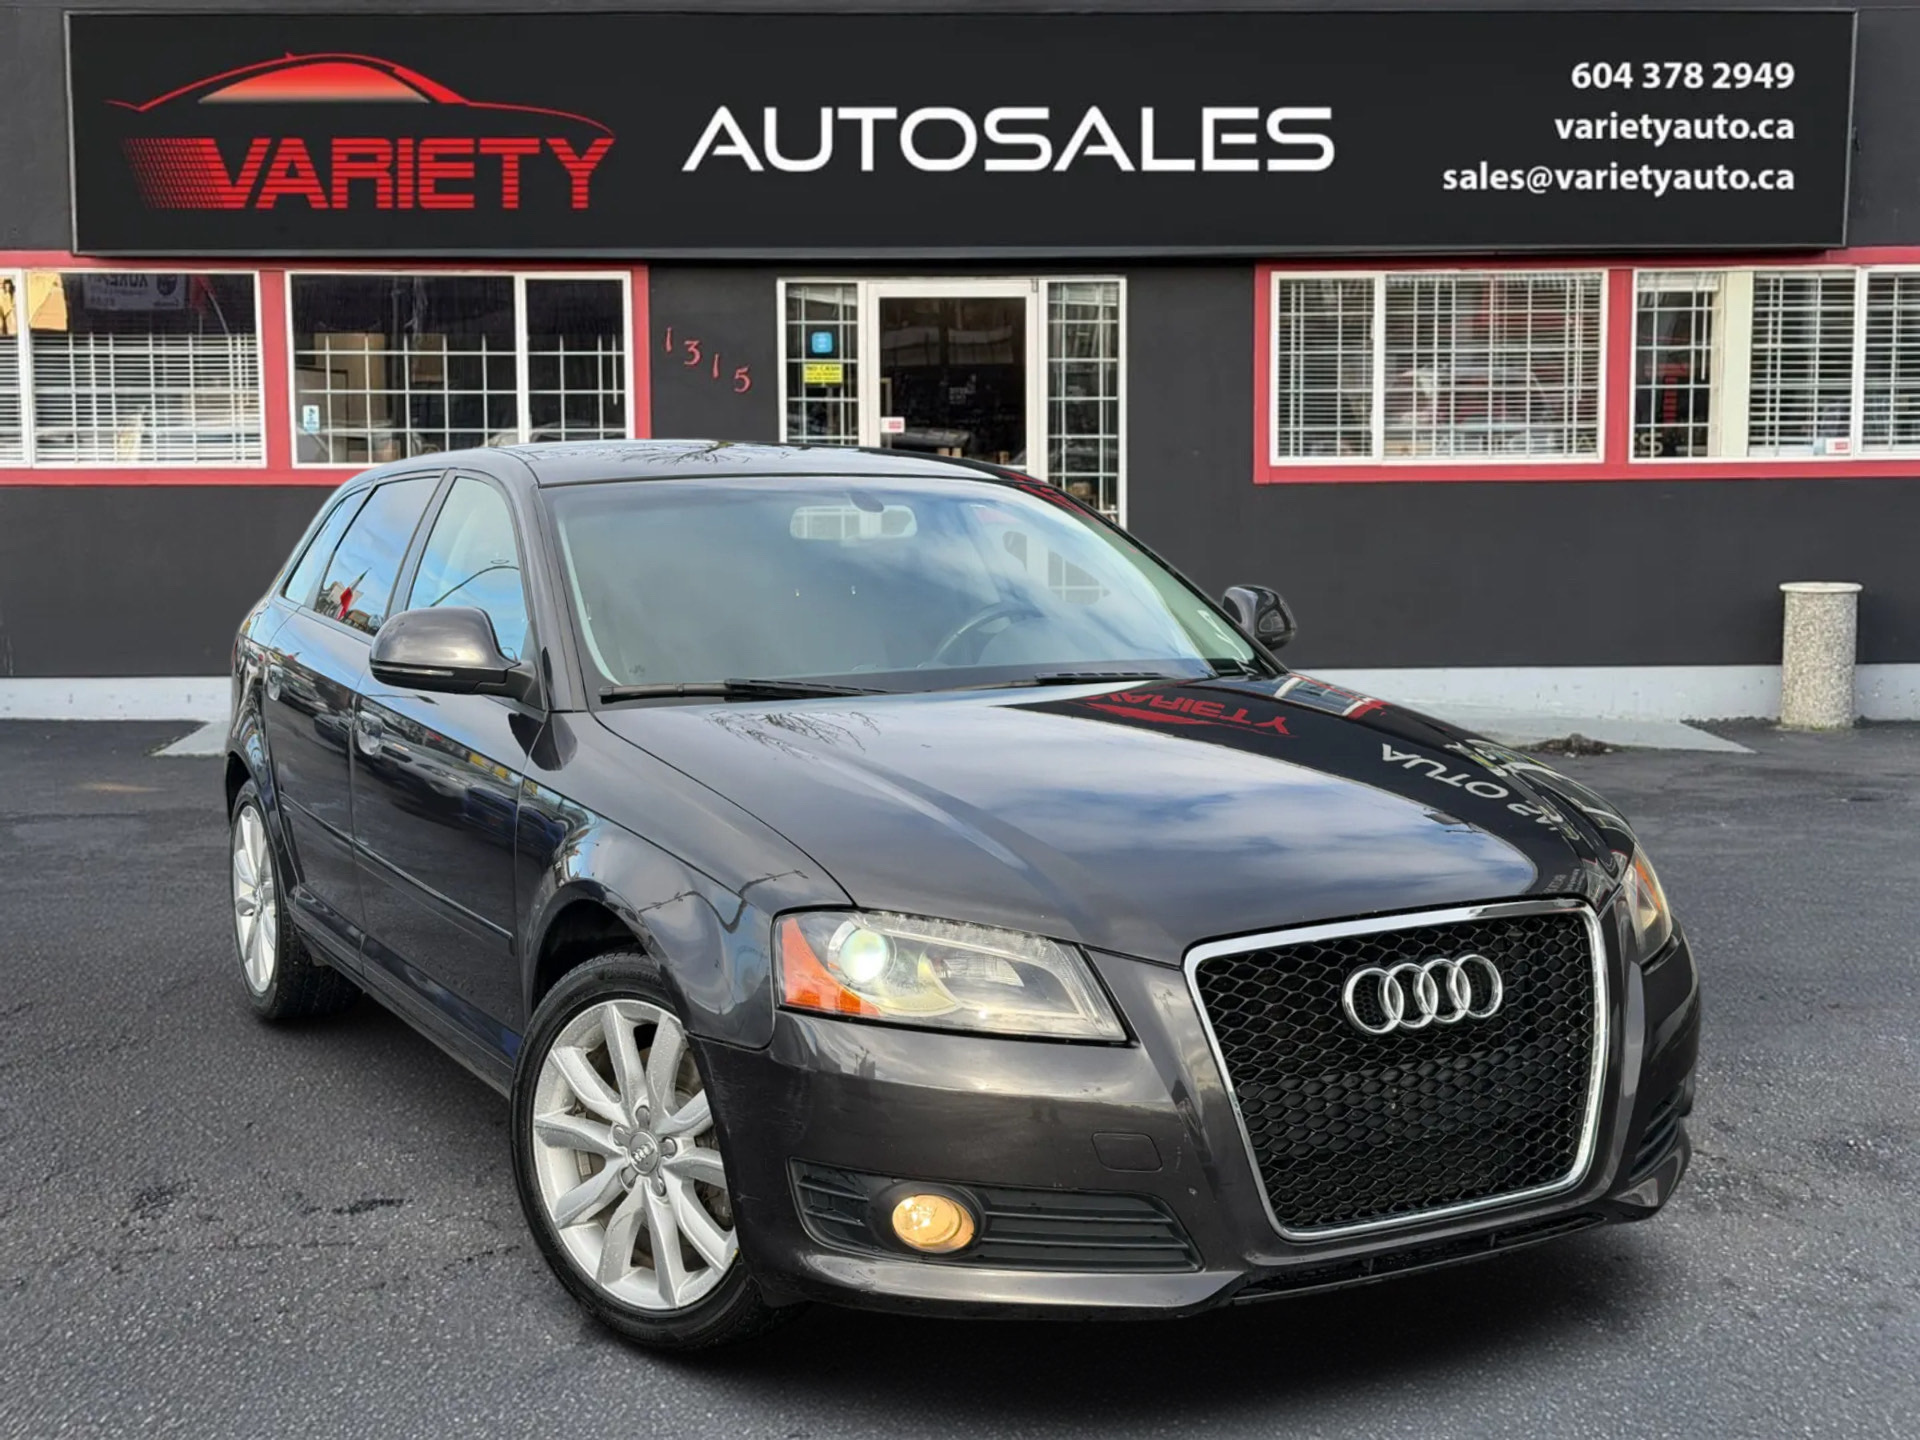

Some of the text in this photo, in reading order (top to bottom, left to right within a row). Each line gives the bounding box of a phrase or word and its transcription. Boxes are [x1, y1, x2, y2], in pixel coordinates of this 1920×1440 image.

[1571, 62, 1795, 89] 604 378 2949
[682, 105, 1335, 173] AUTOSALES
[1554, 111, 1795, 148] varietyauto.ca
[150, 137, 615, 210] VARIETY
[1443, 160, 1795, 198] sales@varietyauto.ca
[665, 327, 753, 393] 1315
